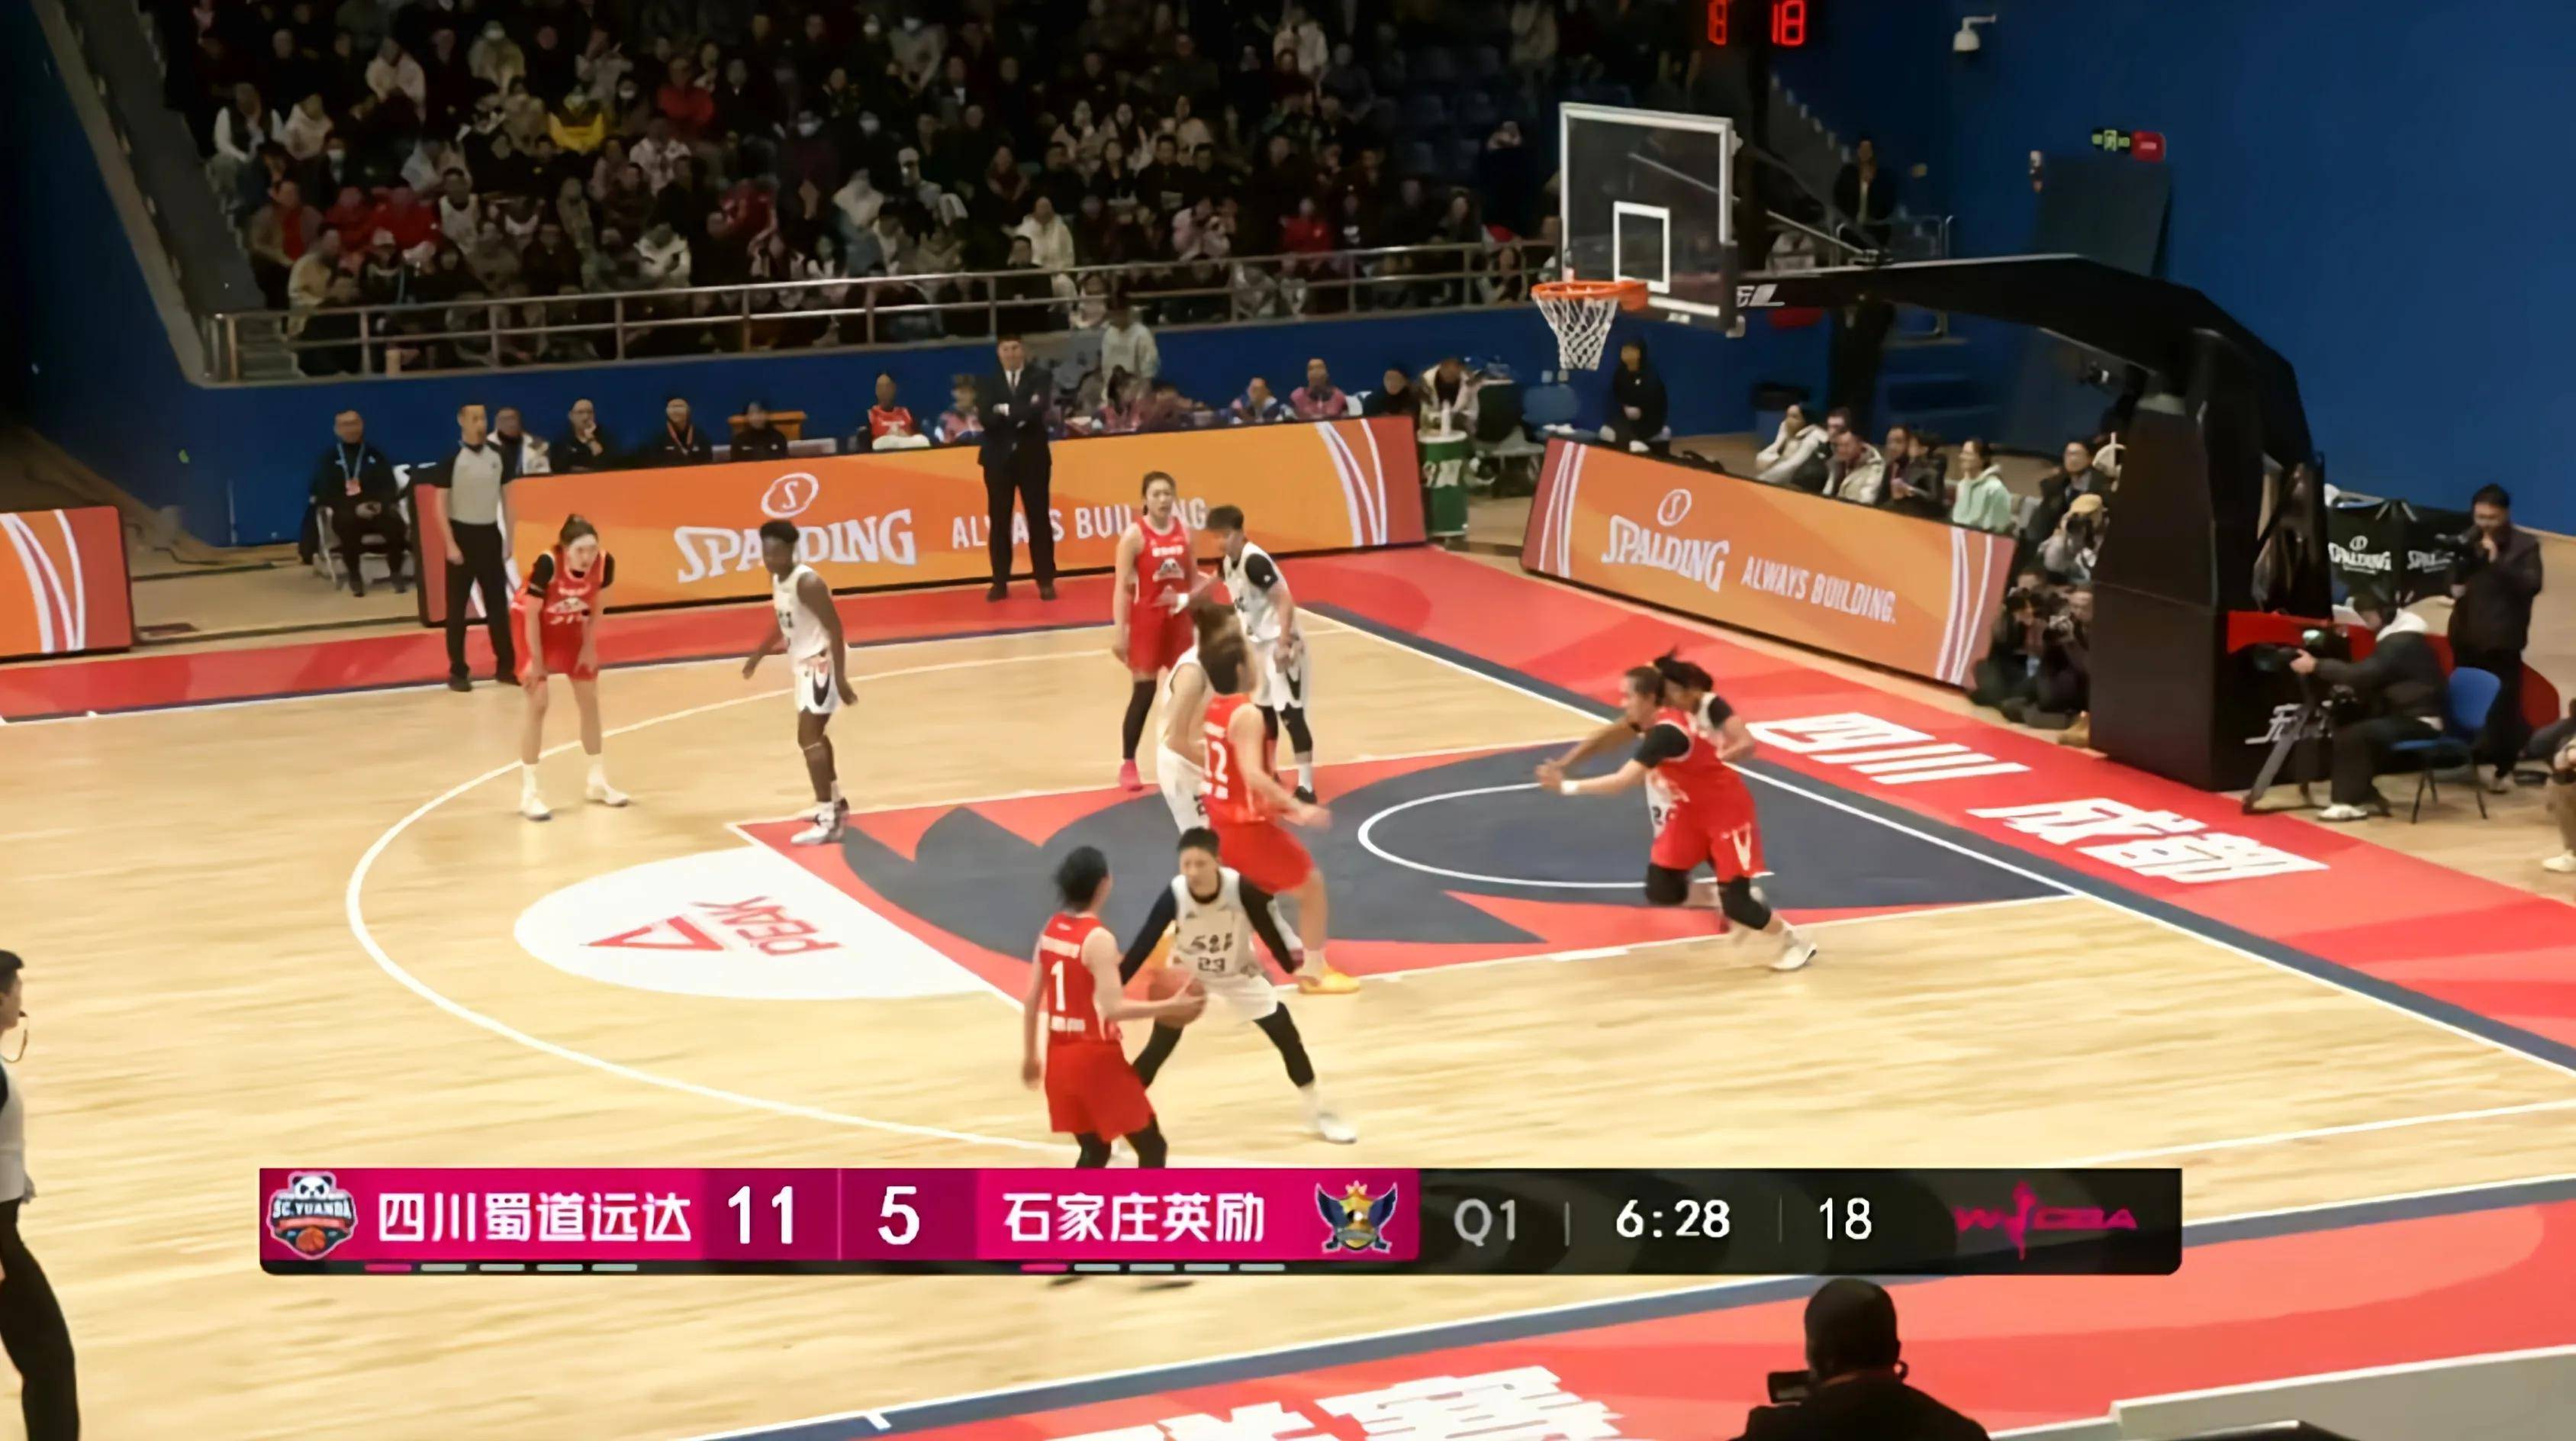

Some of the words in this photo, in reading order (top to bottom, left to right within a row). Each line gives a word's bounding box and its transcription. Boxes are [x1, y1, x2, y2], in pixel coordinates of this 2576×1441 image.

[674, 508, 916, 584] SPADING
[952, 508, 1064, 549] ALAS
[1601, 514, 1731, 592] SPALDING
[1740, 556, 1811, 600] ALWAYS
[1050, 959, 1067, 1012] 1
